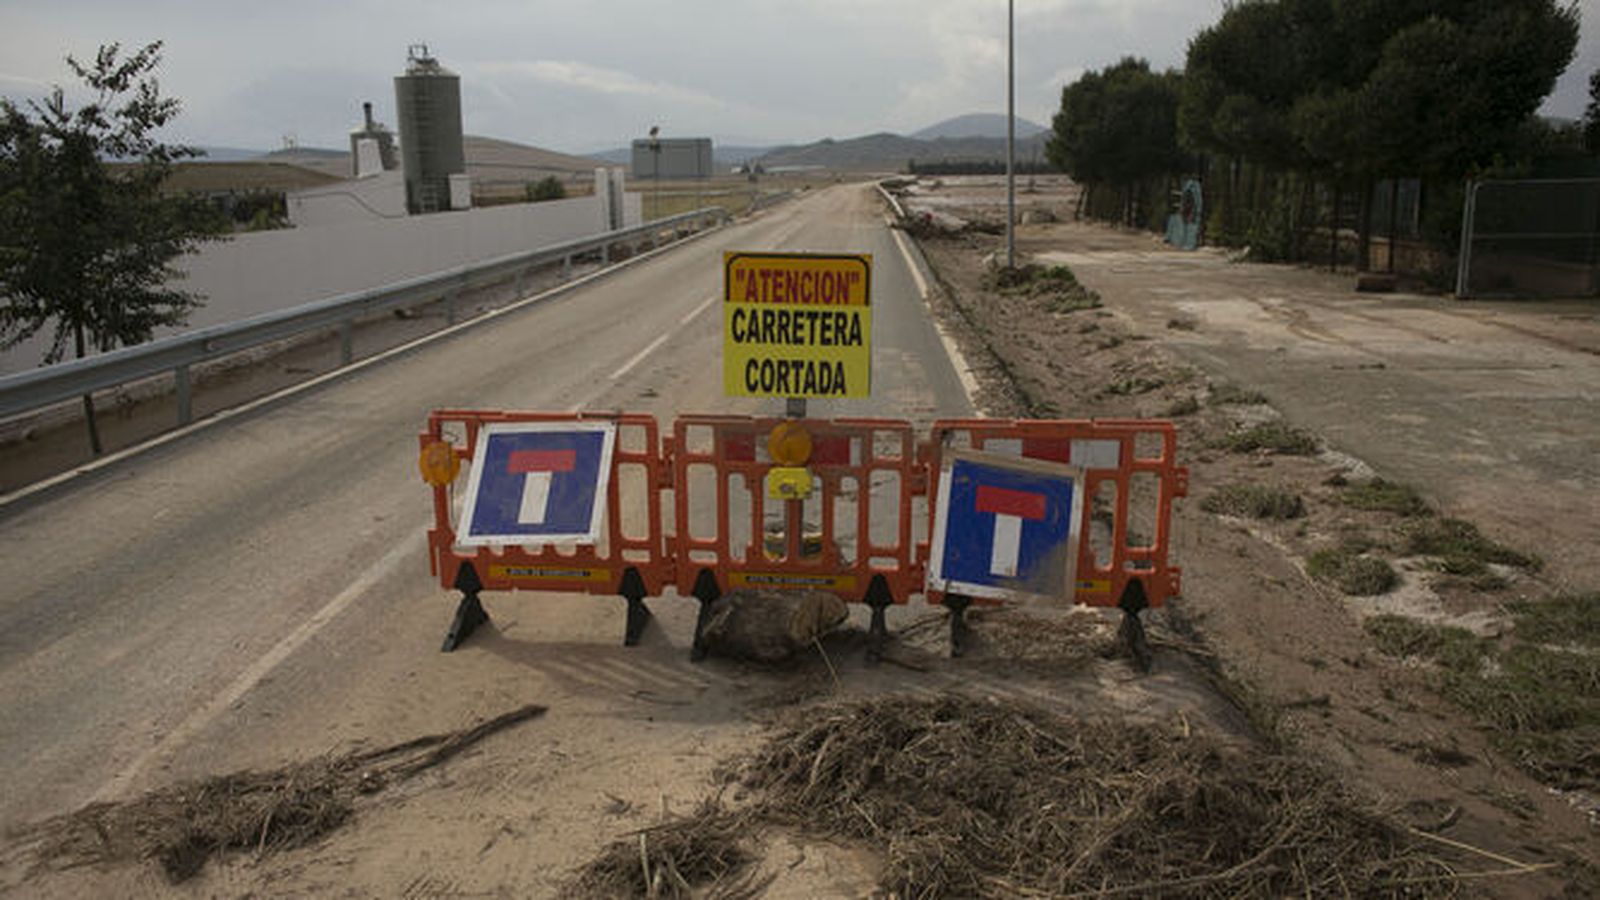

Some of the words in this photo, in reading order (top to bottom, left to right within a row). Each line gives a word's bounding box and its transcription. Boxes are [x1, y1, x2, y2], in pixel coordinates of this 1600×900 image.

[735, 268, 860, 304] "ATENCION"
[731, 307, 863, 346] CARRETERA
[745, 358, 847, 395] CORTADA
